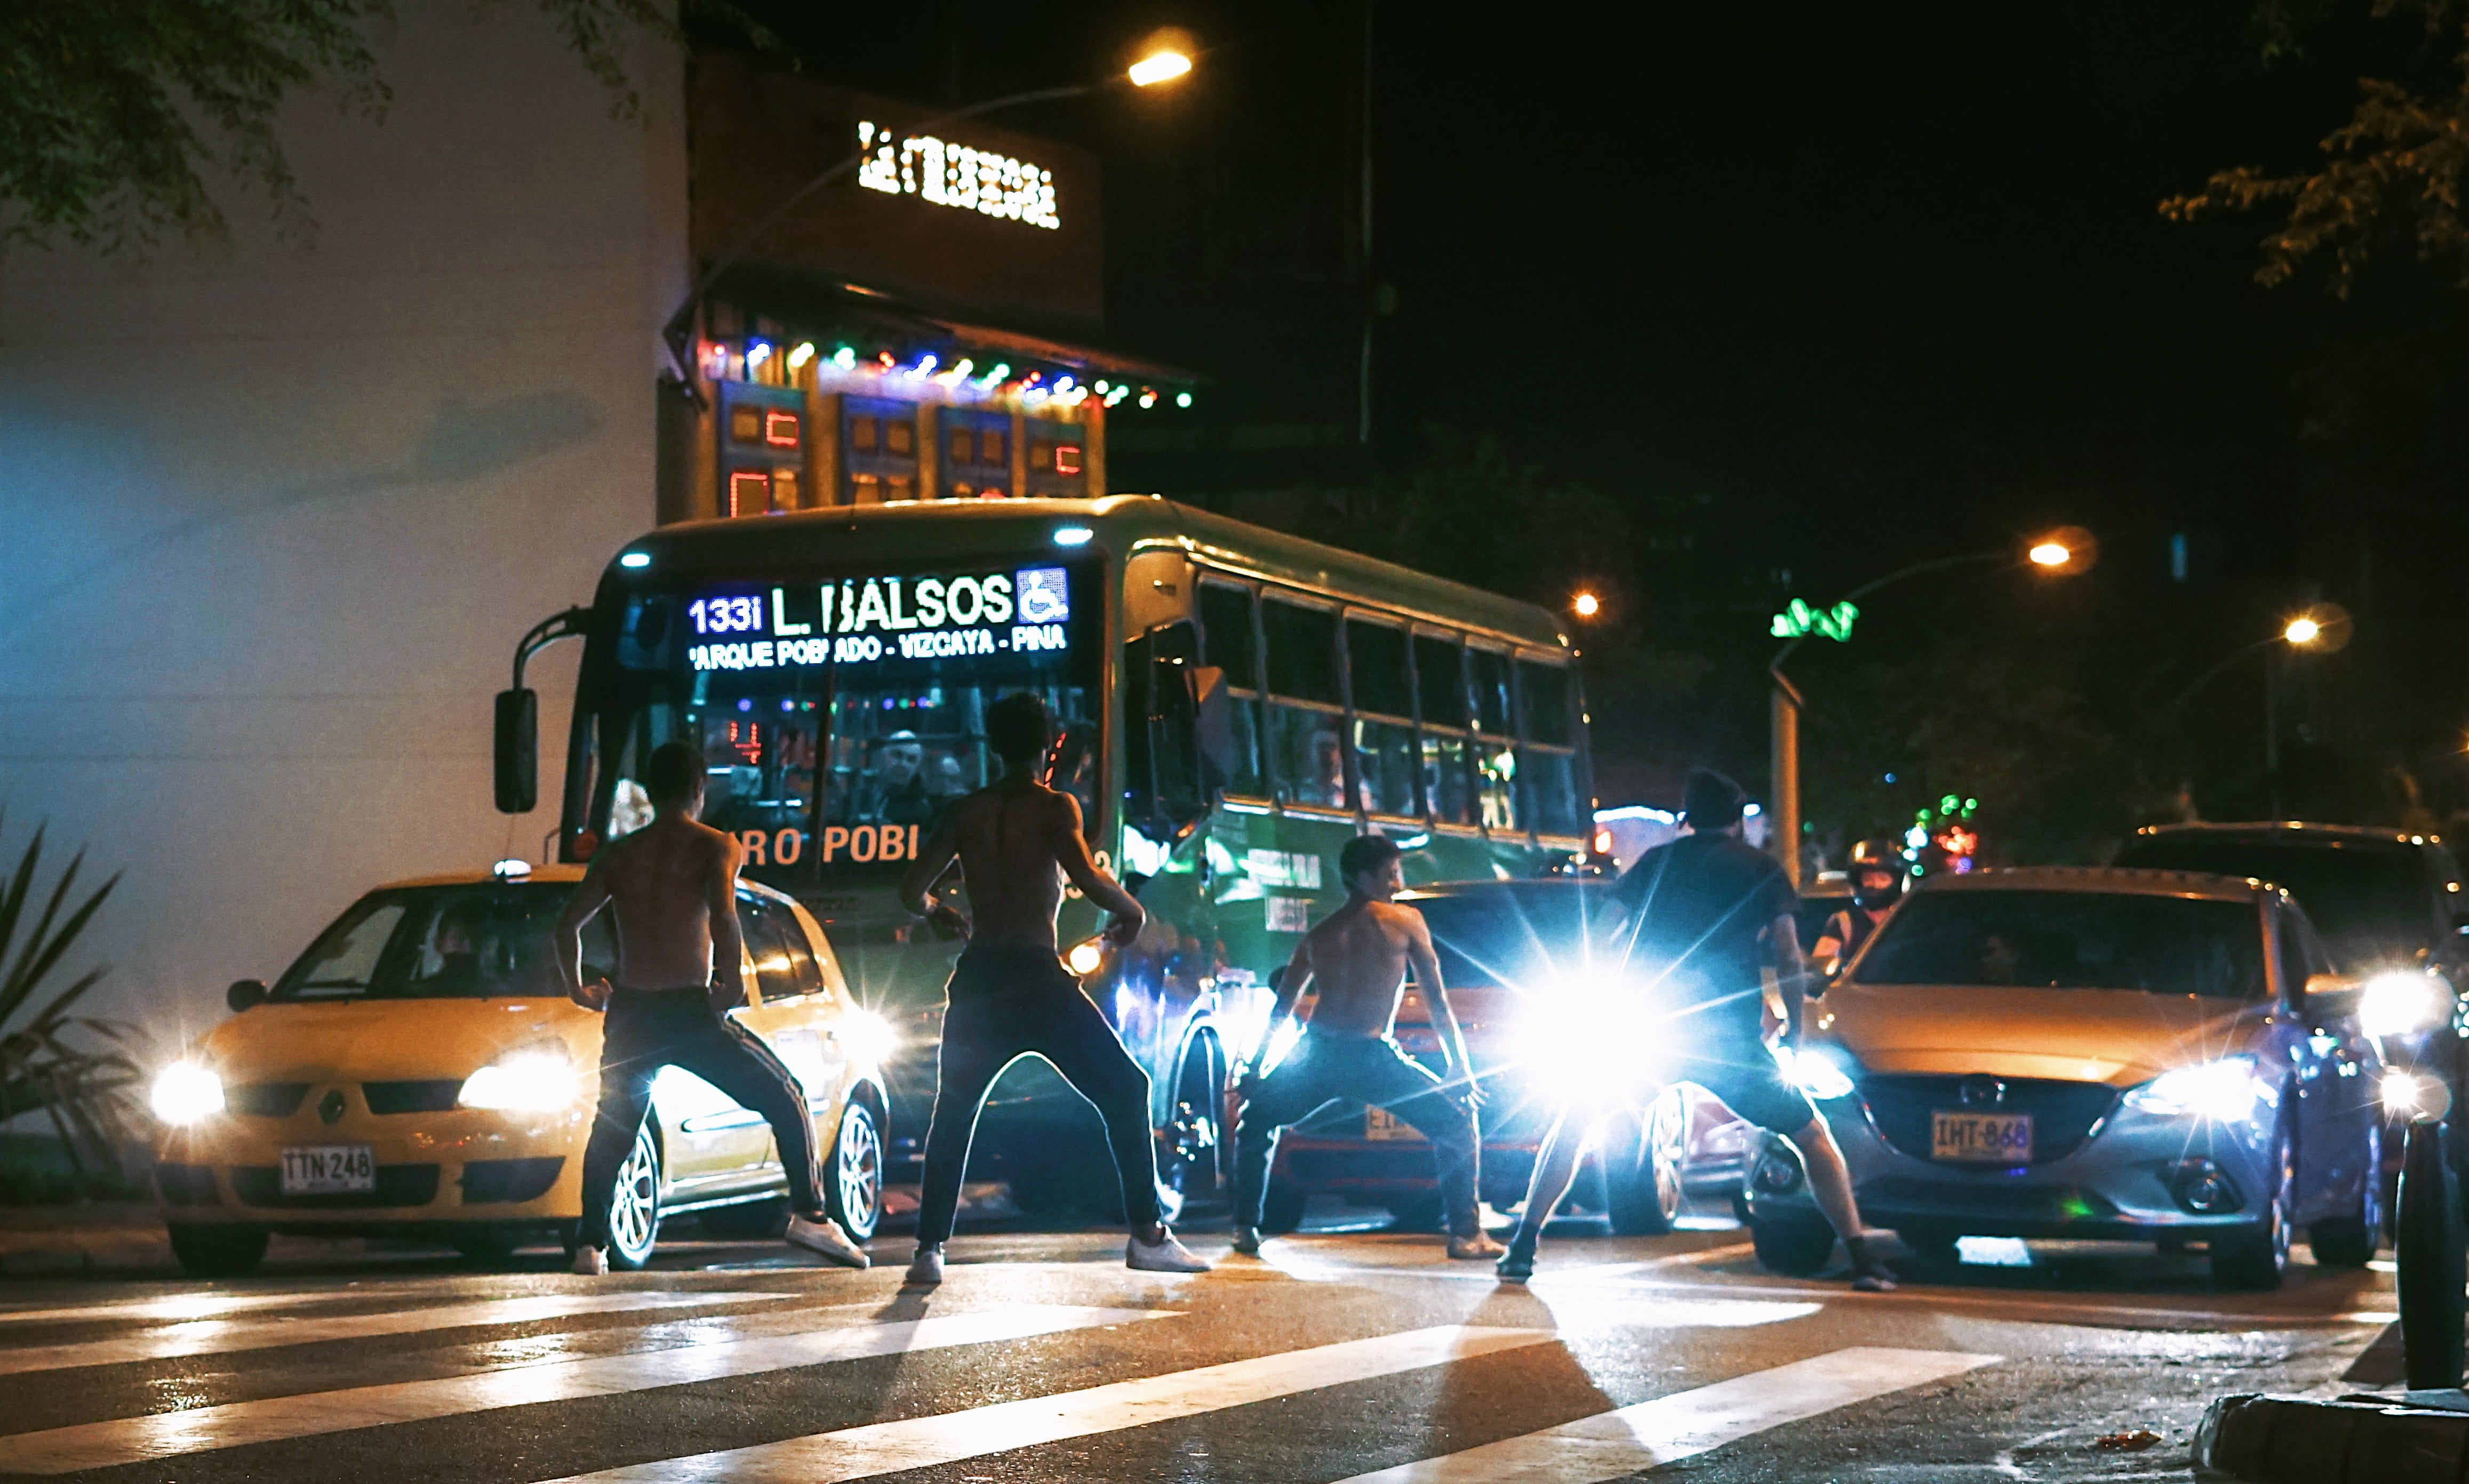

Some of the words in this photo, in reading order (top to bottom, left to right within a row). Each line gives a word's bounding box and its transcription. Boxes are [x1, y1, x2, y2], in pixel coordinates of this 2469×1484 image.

[772, 588, 811, 636] L.
[821, 574, 1012, 633] BALSOS
[689, 641, 773, 670] ARQUE
[898, 629, 996, 659] VIZCAYA
[729, 828, 801, 866] RO
